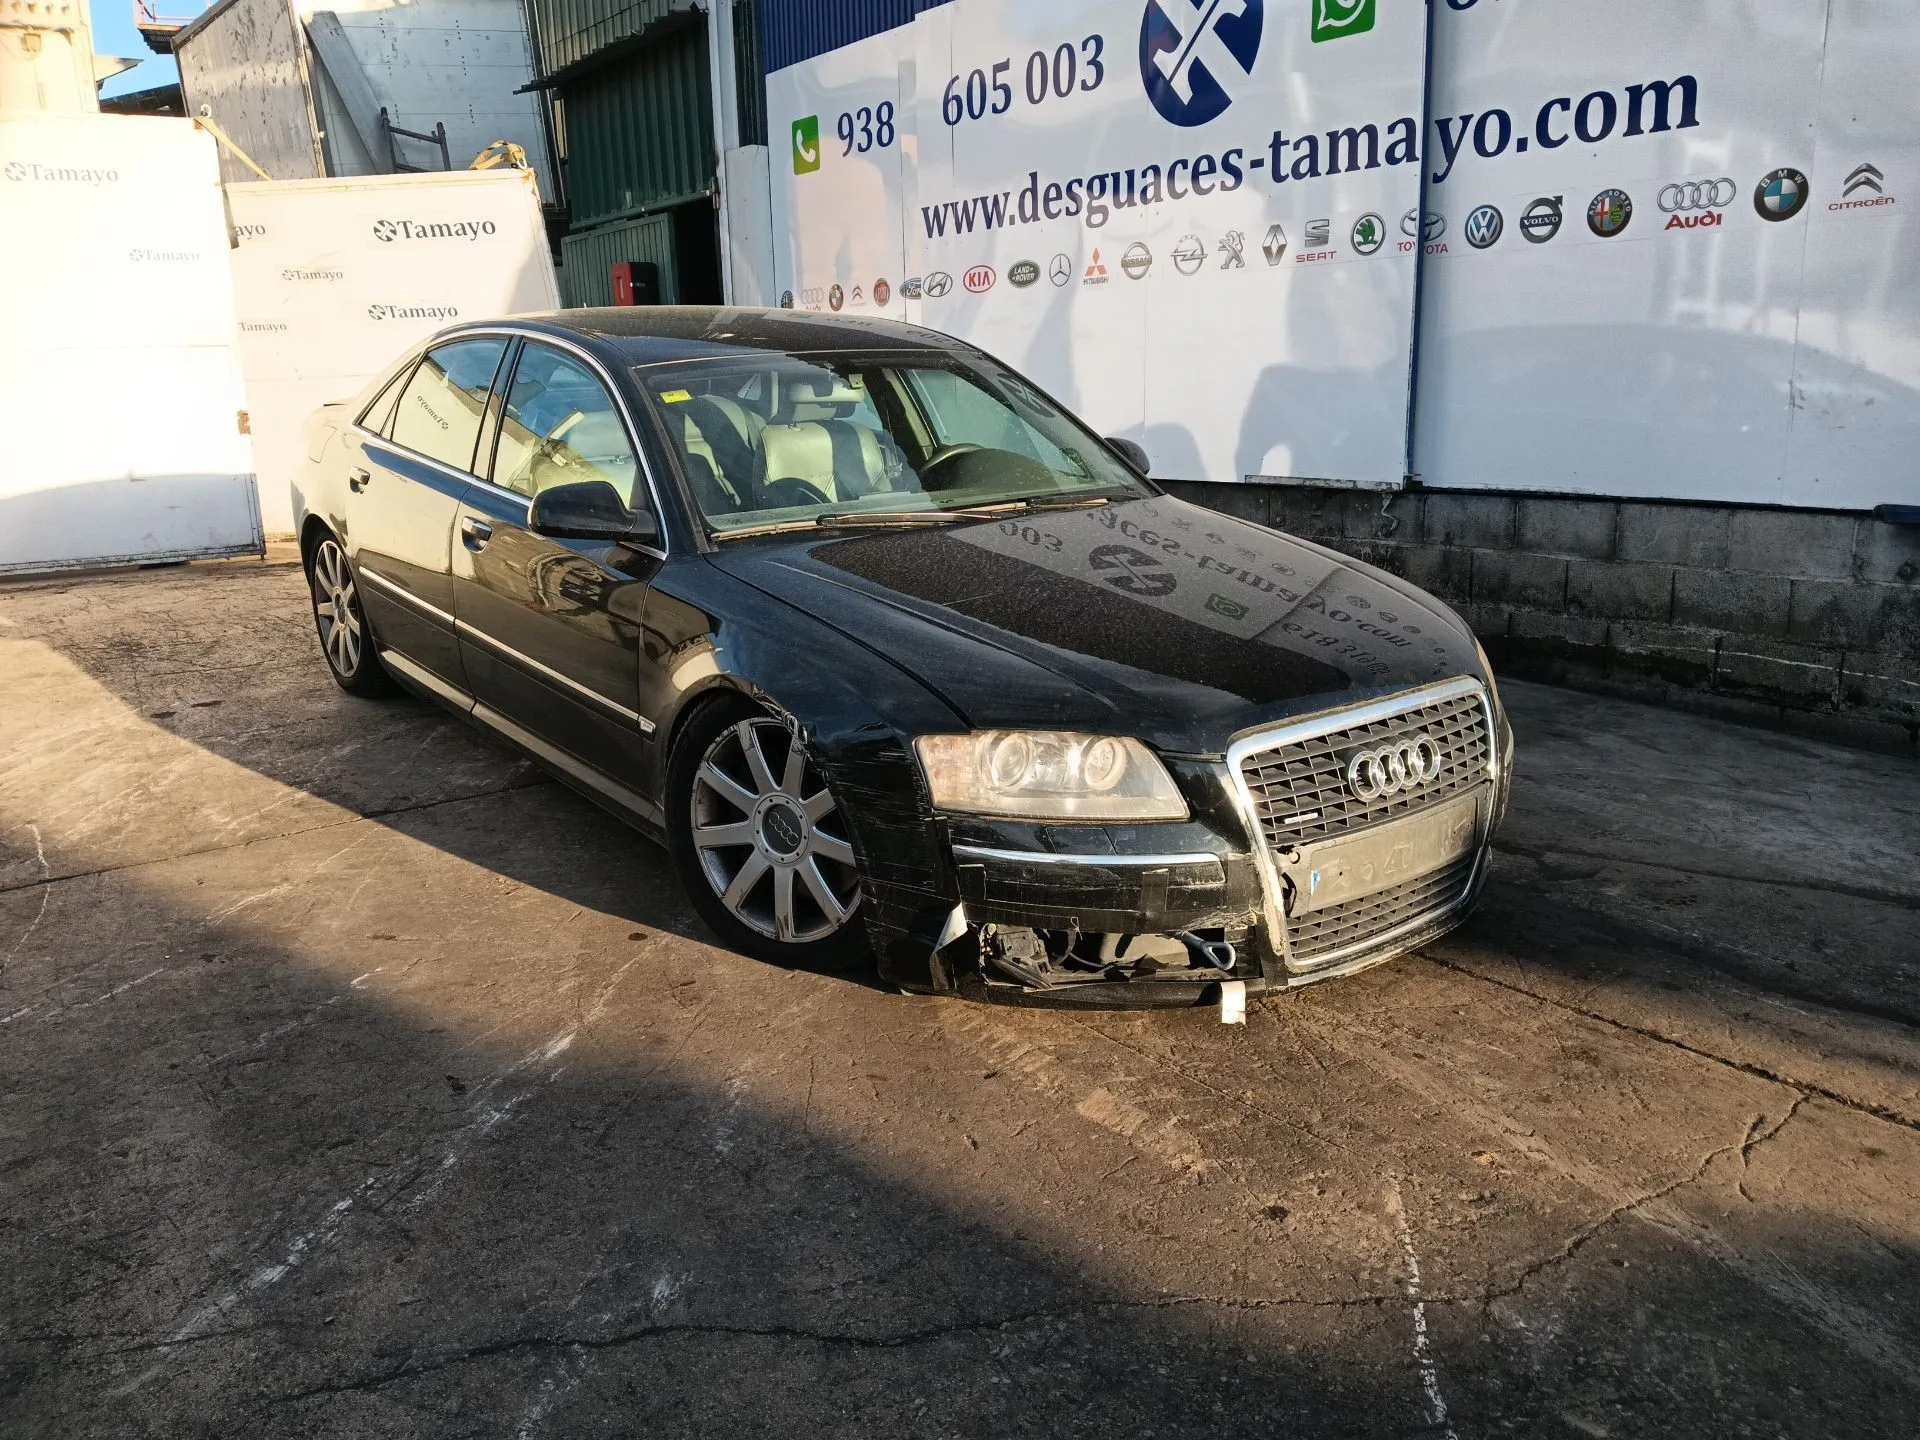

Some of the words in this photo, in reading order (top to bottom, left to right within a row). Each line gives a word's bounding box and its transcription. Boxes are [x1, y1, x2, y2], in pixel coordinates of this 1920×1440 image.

[837, 101, 895, 157] 938
[942, 58, 1012, 126] 605
[1026, 34, 1104, 104] 003
[921, 74, 1700, 239] www.desguaces-tamayo.com
[27, 164, 119, 187] Tamayo
[1760, 169, 1804, 188] BMW
[1522, 215, 1559, 225] VOLVO
[234, 223, 266, 240] ayo
[397, 220, 497, 241] Tamayo
[143, 249, 200, 263] Tamayo
[1295, 250, 1337, 263] SEAT
[294, 269, 344, 281] Tamayo
[968, 274, 991, 288] KIA
[385, 304, 458, 321] Tamayo
[237, 321, 287, 332] Tamayo
